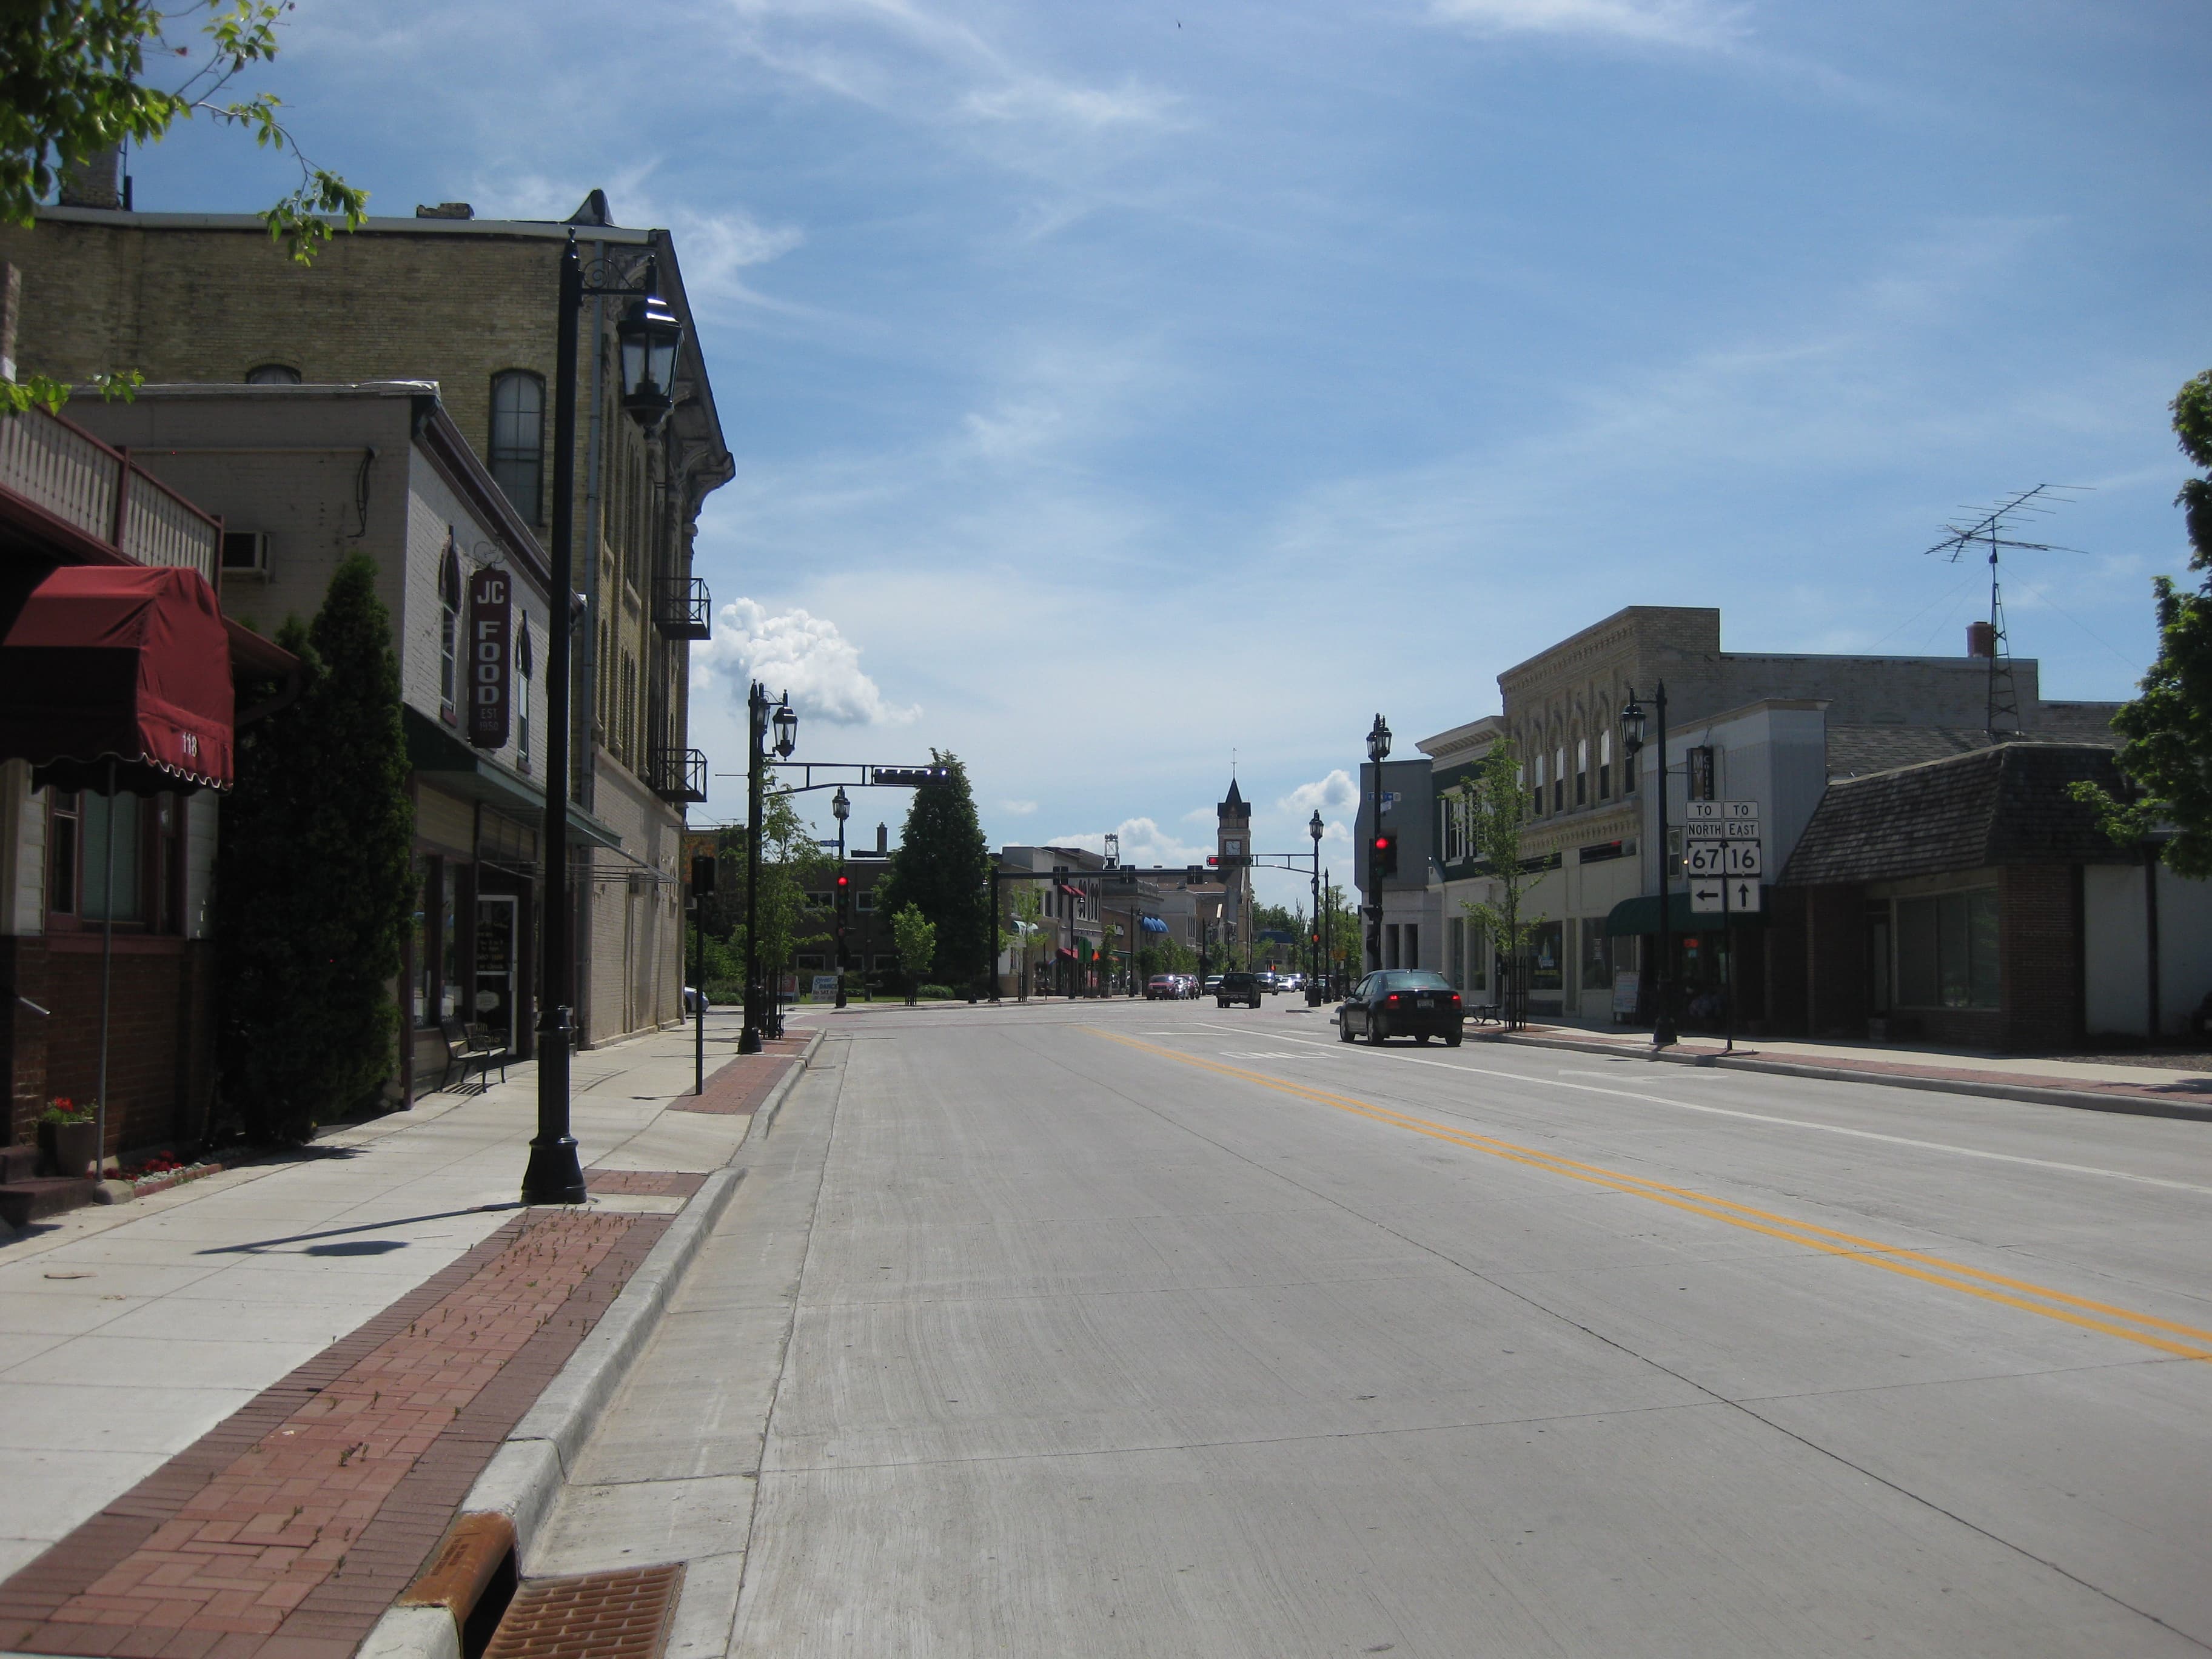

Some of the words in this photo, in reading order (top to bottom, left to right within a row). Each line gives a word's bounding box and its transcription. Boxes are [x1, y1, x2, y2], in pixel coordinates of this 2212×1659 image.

[477, 580, 504, 605] JC
[478, 620, 501, 705] FOOD
[480, 708, 498, 719] EST
[183, 732, 197, 757] 118
[1697, 805, 1712, 816] TO
[1733, 805, 1749, 816] TO
[1688, 824, 1721, 835] NORTH
[1729, 823, 1755, 835] EAST
[1692, 849, 1718, 869] 67
[1732, 848, 1755, 868] 16
